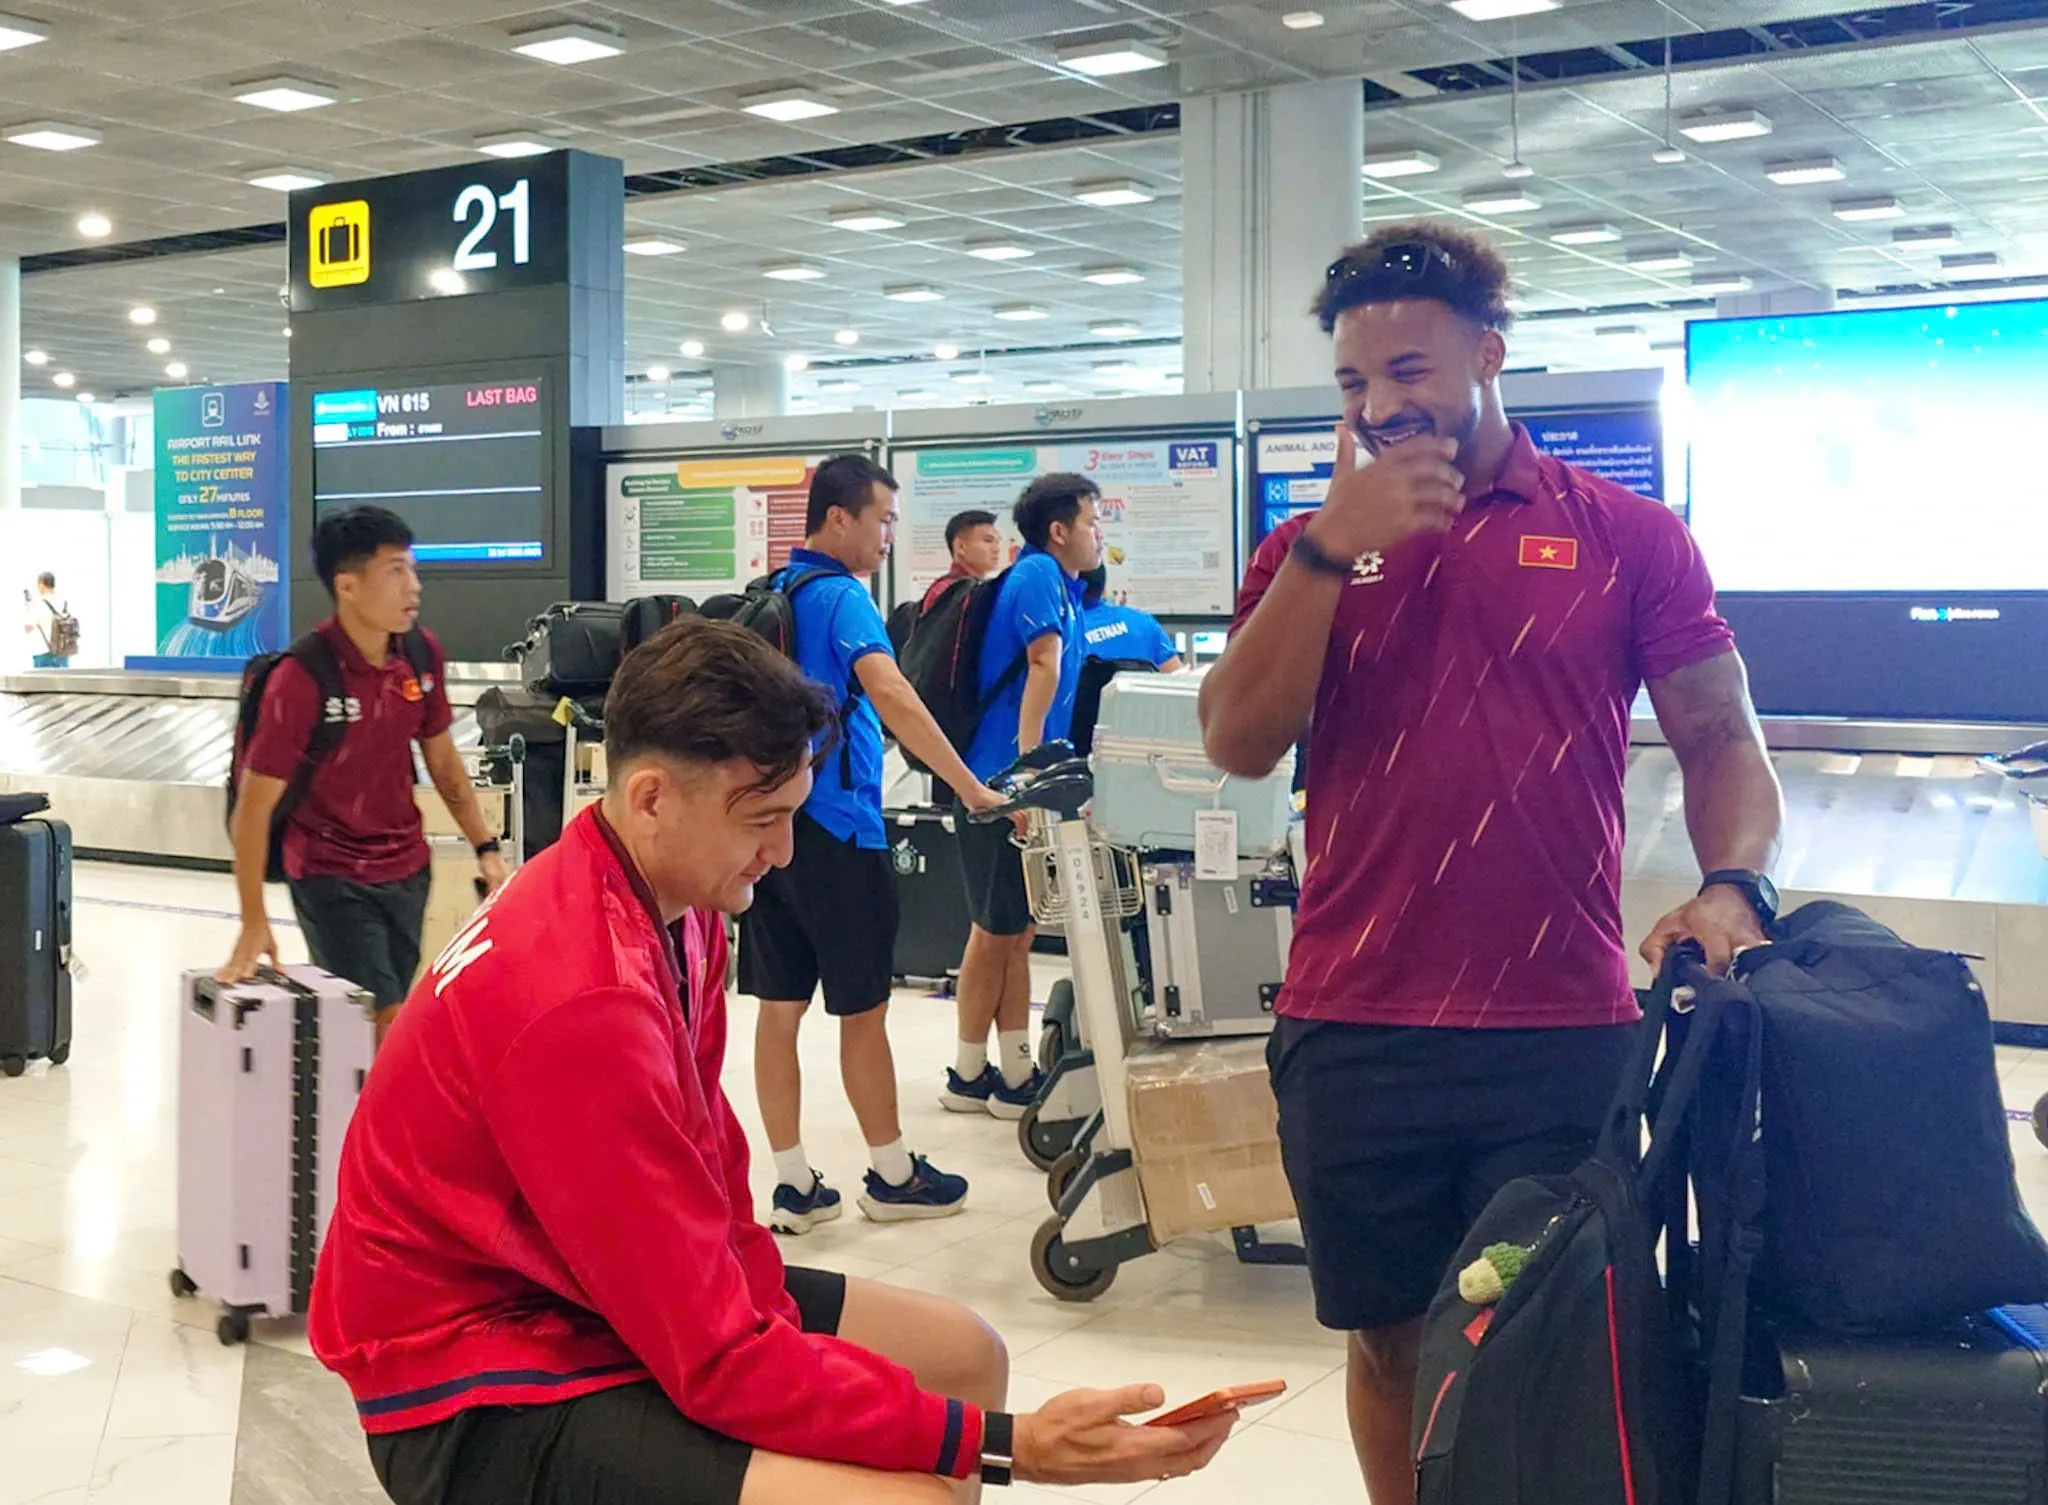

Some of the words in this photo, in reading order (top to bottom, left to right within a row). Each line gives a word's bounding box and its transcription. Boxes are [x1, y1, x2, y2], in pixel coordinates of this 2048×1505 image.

[453, 179, 530, 271] 21
[377, 394, 399, 413] VN
[402, 392, 430, 412] 615
[466, 388, 503, 407] LAST
[506, 386, 537, 403] BAG
[377, 422, 408, 437] From
[167, 436, 211, 450] AIRPORT
[1265, 443, 1309, 454] ANIMAL
[1311, 441, 1336, 452] AND
[1083, 449, 1101, 472] 3
[1175, 446, 1209, 461] VAT
[174, 470, 189, 483] TO
[190, 469, 213, 482] CITY
[213, 467, 254, 480] CENTER
[199, 486, 218, 503] 27
[1084, 620, 1129, 645] VIETNAM
